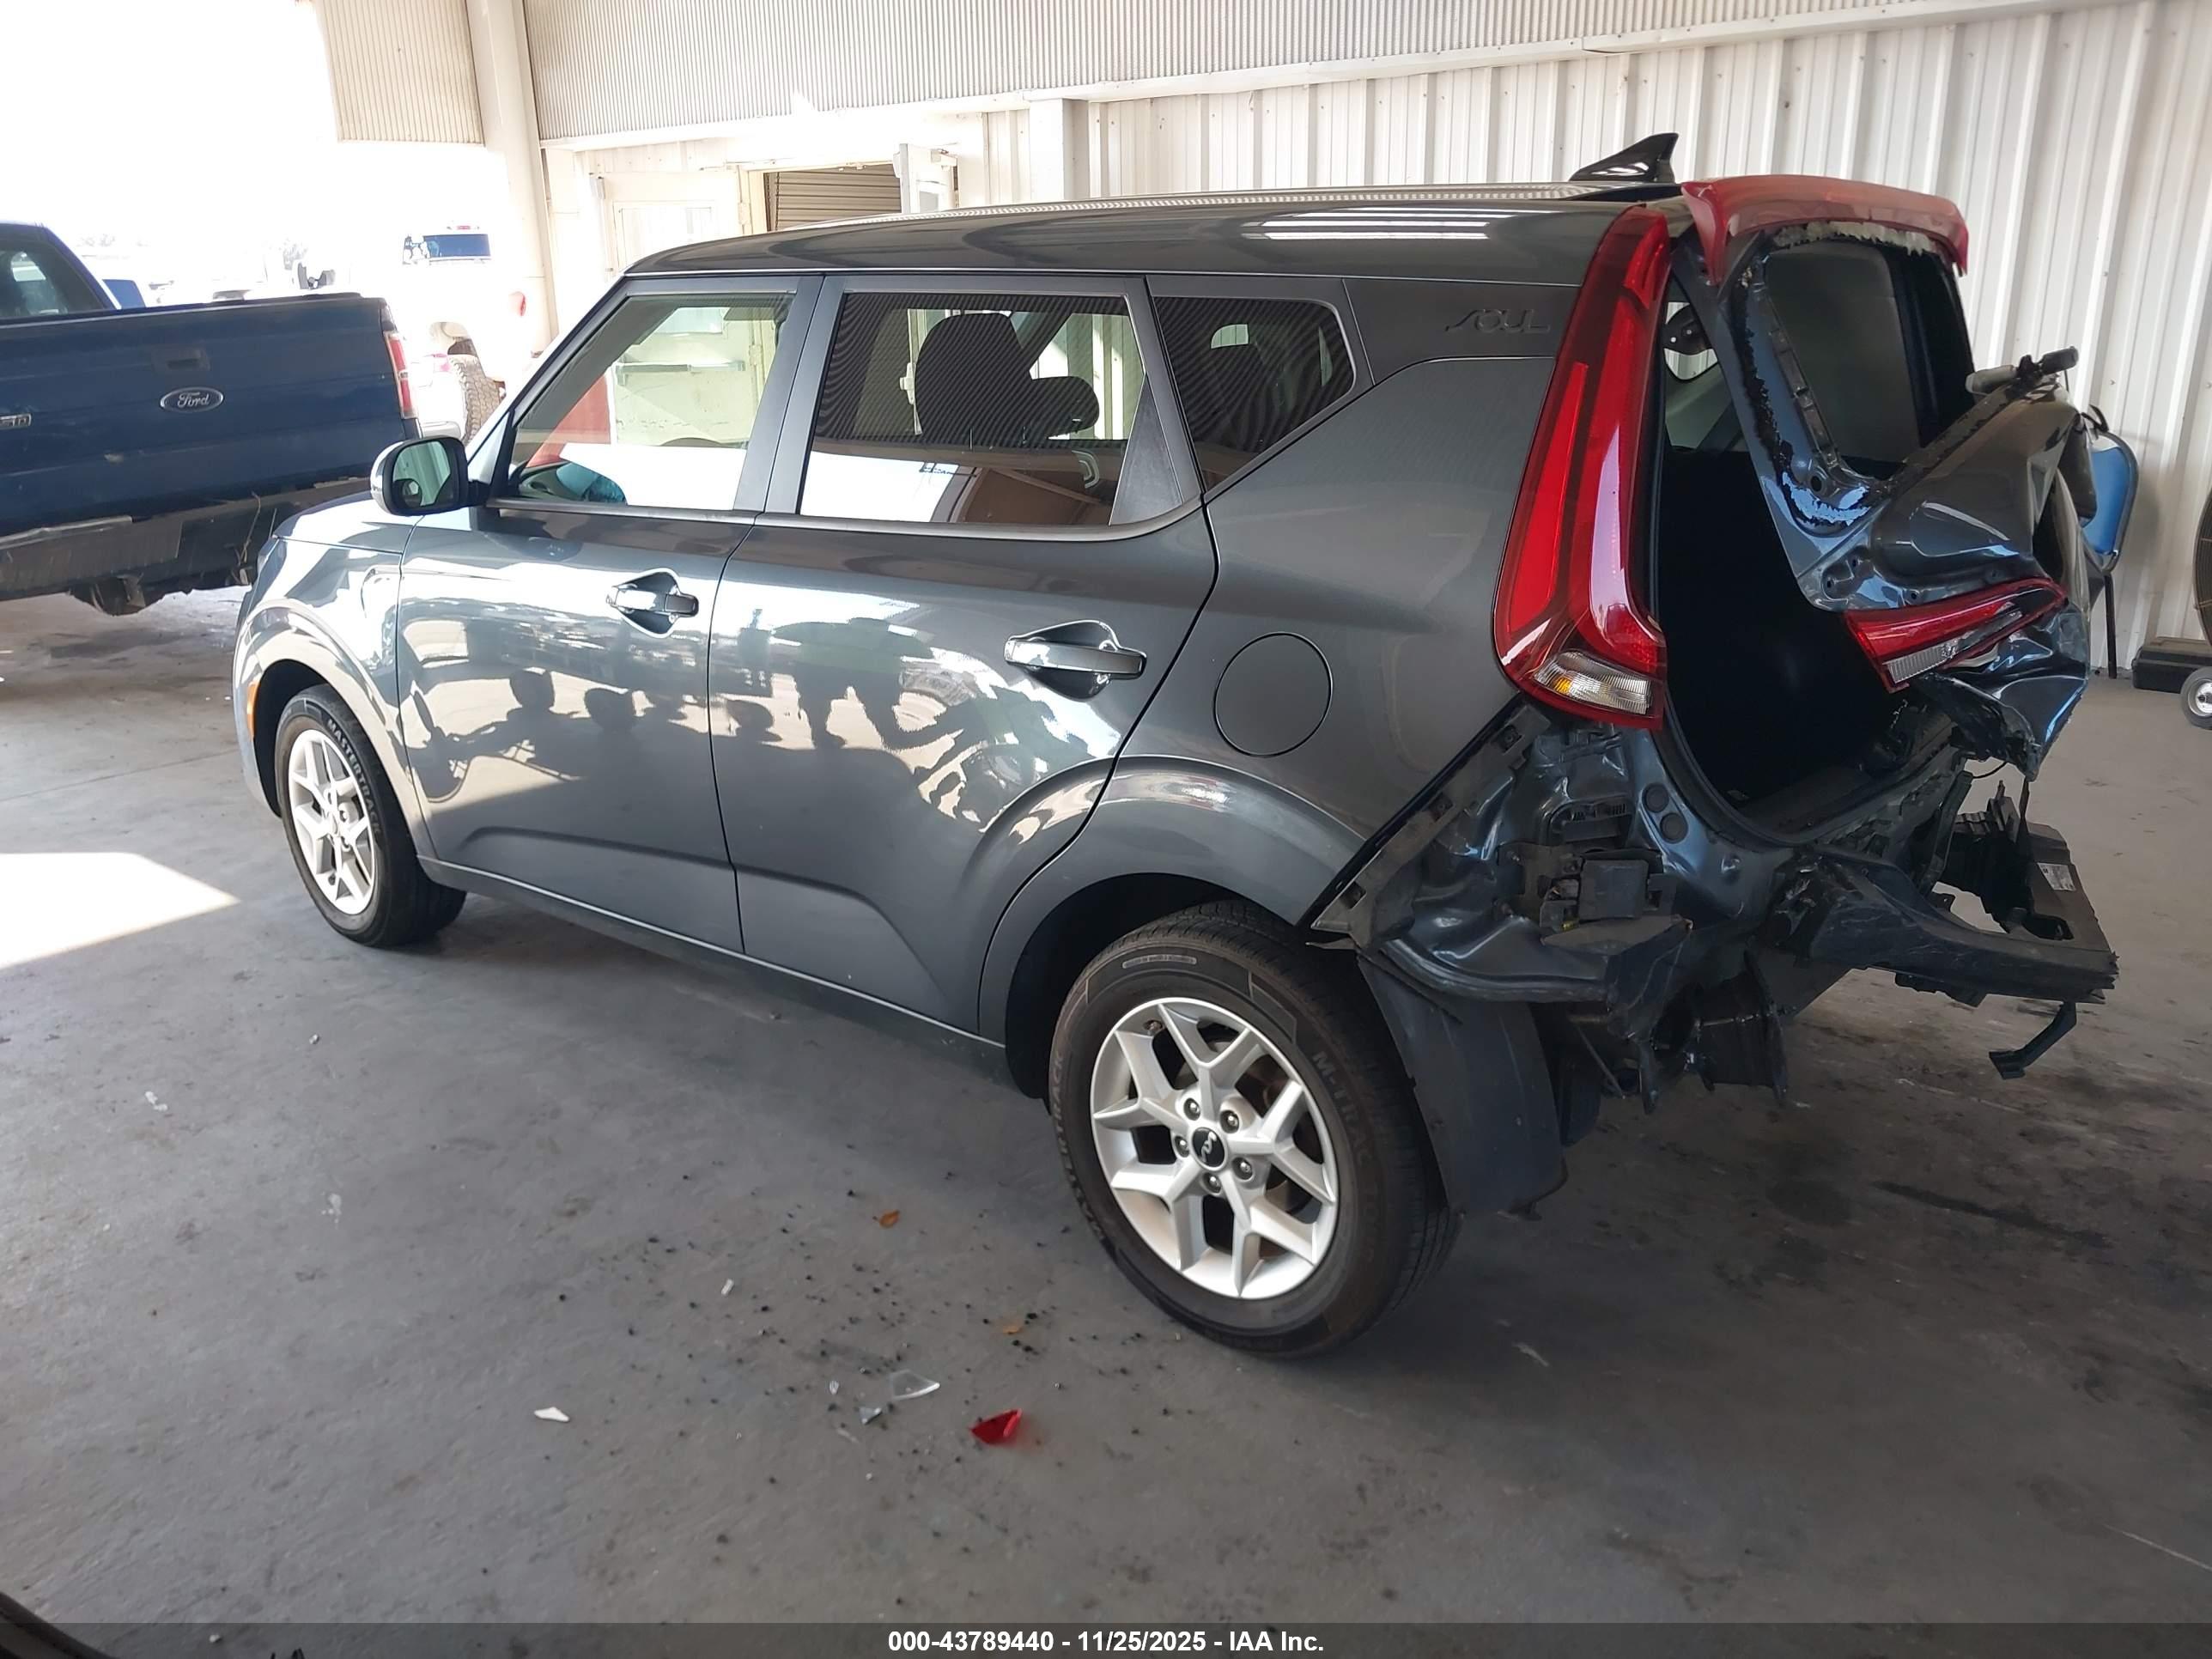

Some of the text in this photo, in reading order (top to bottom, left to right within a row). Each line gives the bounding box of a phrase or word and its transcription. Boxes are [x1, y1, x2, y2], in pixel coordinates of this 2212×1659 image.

[1444, 308, 1551, 334] SOUL
[177, 392, 210, 409] Ford
[326, 718, 382, 835] MASTERTRACK
[1311, 1050, 1371, 1167] M-TRAC
